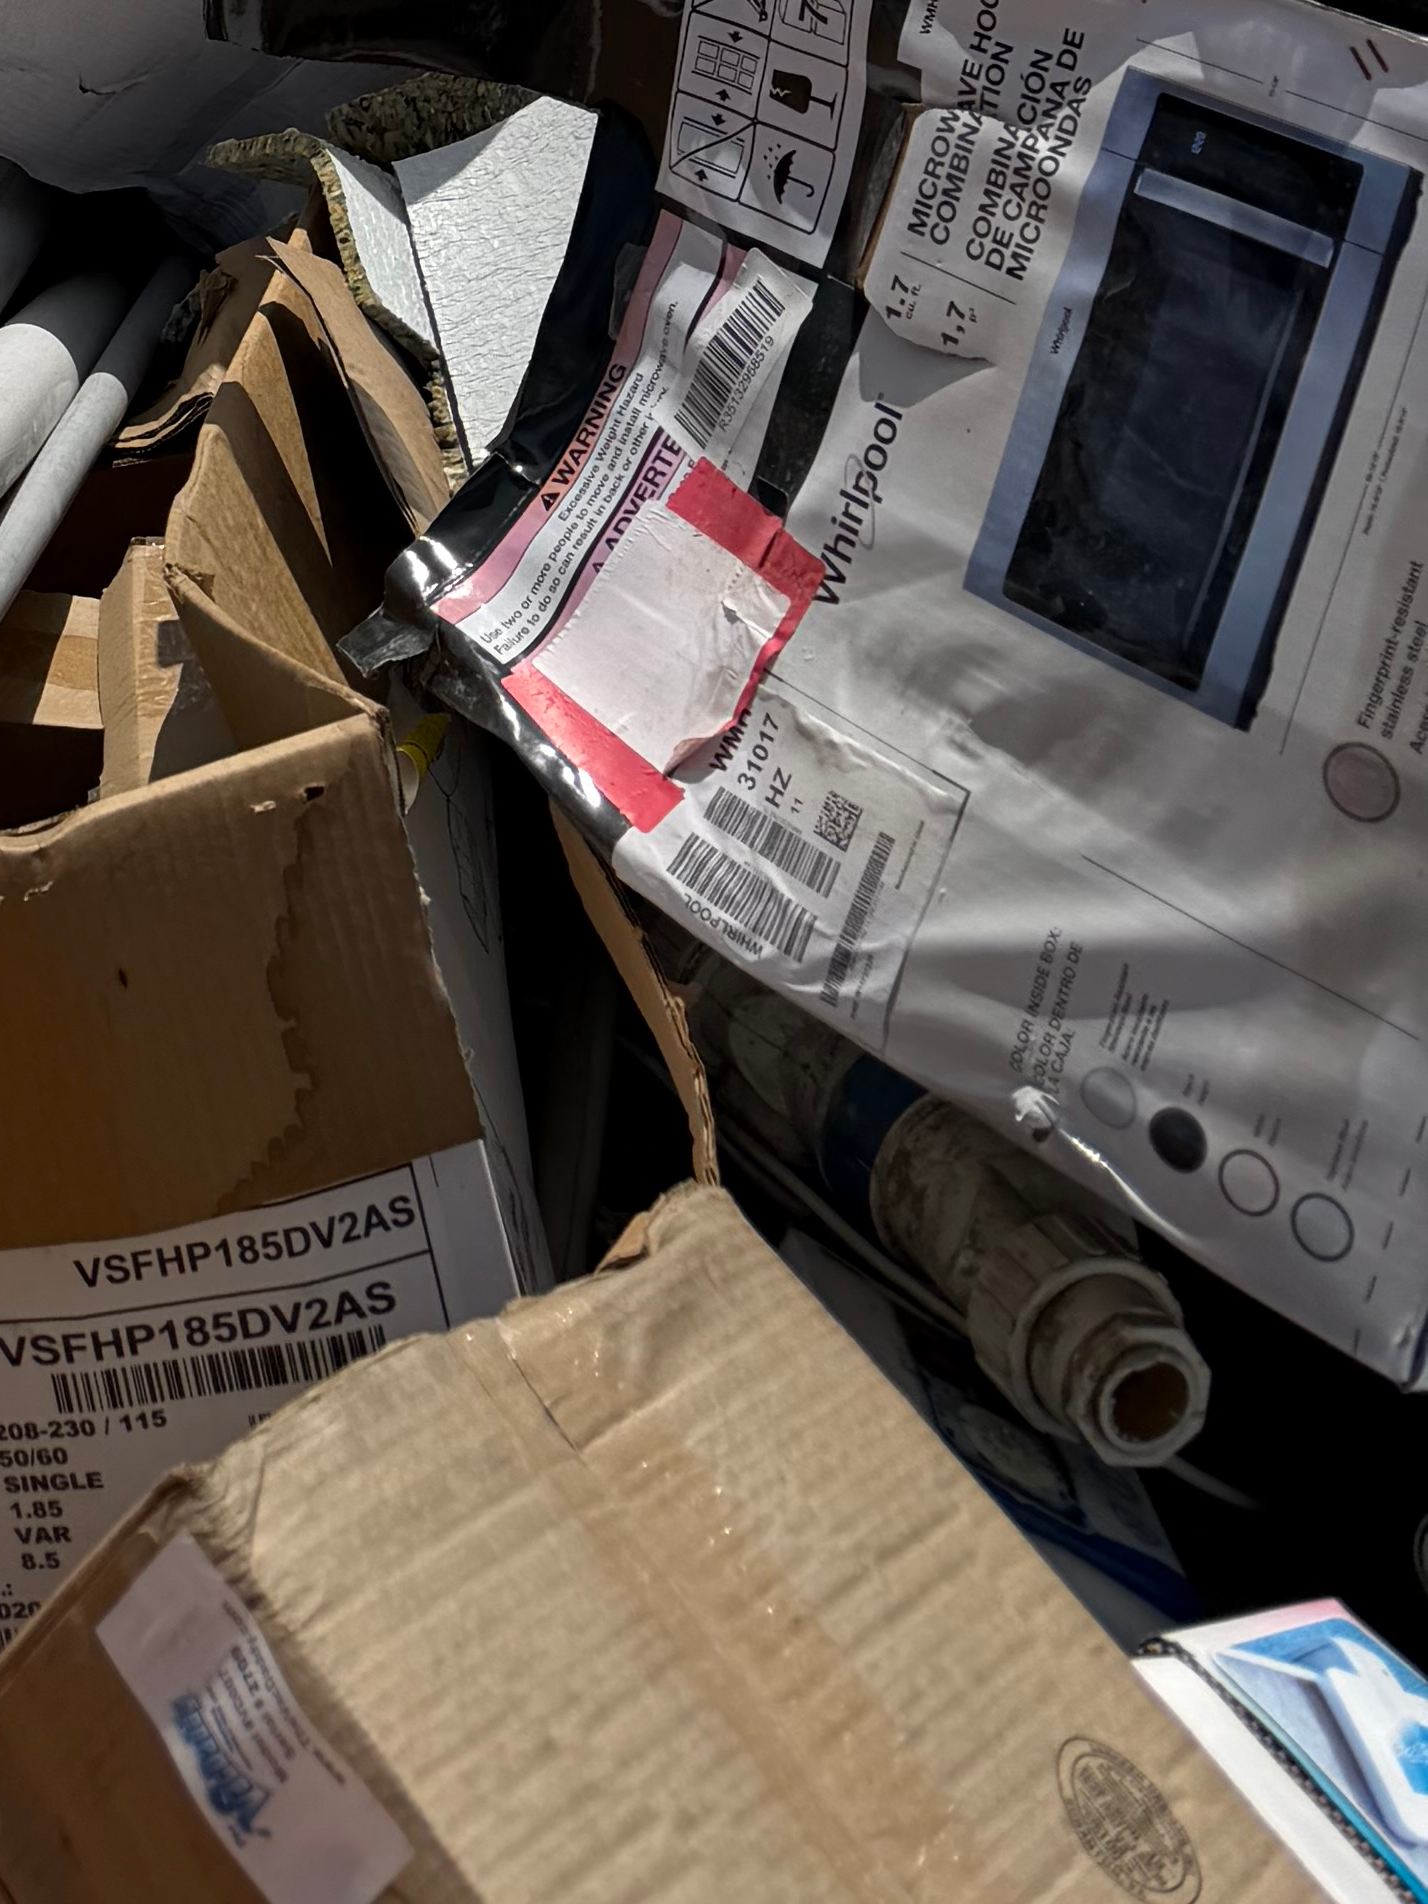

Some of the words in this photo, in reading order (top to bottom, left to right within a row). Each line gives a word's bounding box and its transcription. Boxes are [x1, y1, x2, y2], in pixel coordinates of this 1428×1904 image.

[908, 61, 982, 236] MICROWAVE
[930, 42, 1012, 244] COMBINATION
[966, 50, 1052, 260] COMBINACIÓN
[984, 226, 1014, 271] DE
[1002, 81, 1070, 221] CAMPANA
[1056, 28, 1085, 71] DE
[1006, 77, 1091, 280] MICROONDAS
[880, 273, 914, 322] 1.7
[552, 359, 629, 492] WARNING
[558, 464, 600, 521] Excessive
[595, 418, 622, 461] Weight
[616, 373, 644, 417] Hazard
[625, 418, 654, 457] other
[598, 467, 628, 506] back
[618, 453, 637, 472] or
[480, 628, 503, 643] Use
[500, 610, 523, 629] two
[515, 592, 535, 612] or
[530, 563, 551, 595] more
[548, 522, 578, 562] people
[572, 504, 590, 523] to
[586, 473, 609, 507] move
[607, 446, 623, 472] and
[615, 407, 642, 445] install
[639, 344, 667, 406] microwave
[593, 505, 606, 517] in
[801, 399, 914, 610] Whirlpool
[572, 518, 598, 550] result
[544, 574, 564, 595] so
[557, 552, 575, 575] can
[524, 610, 542, 628] to
[533, 592, 554, 614] do
[494, 626, 530, 655] Failure
[1357, 561, 1422, 727] Fingerprint-resistant
[1381, 666, 1413, 739] stainless
[1404, 618, 1428, 663] steel
[737, 713, 778, 790] 31017
[765, 767, 792, 808] HZ
[678, 894, 763, 954] WHIRLPOOL
[1024, 966, 1050, 1017] INSIDE
[1048, 966, 1076, 1031] DENTRO
[1066, 942, 1083, 964] DE
[74, 1193, 414, 1292] VSFHP185DV2AS
[119, 1409, 167, 1432] 115
[4, 1471, 103, 1493] SINGLE
[10, 1500, 63, 1519] 1.85
[14, 1526, 71, 1544] VAR
[21, 1551, 60, 1570] 8.5
